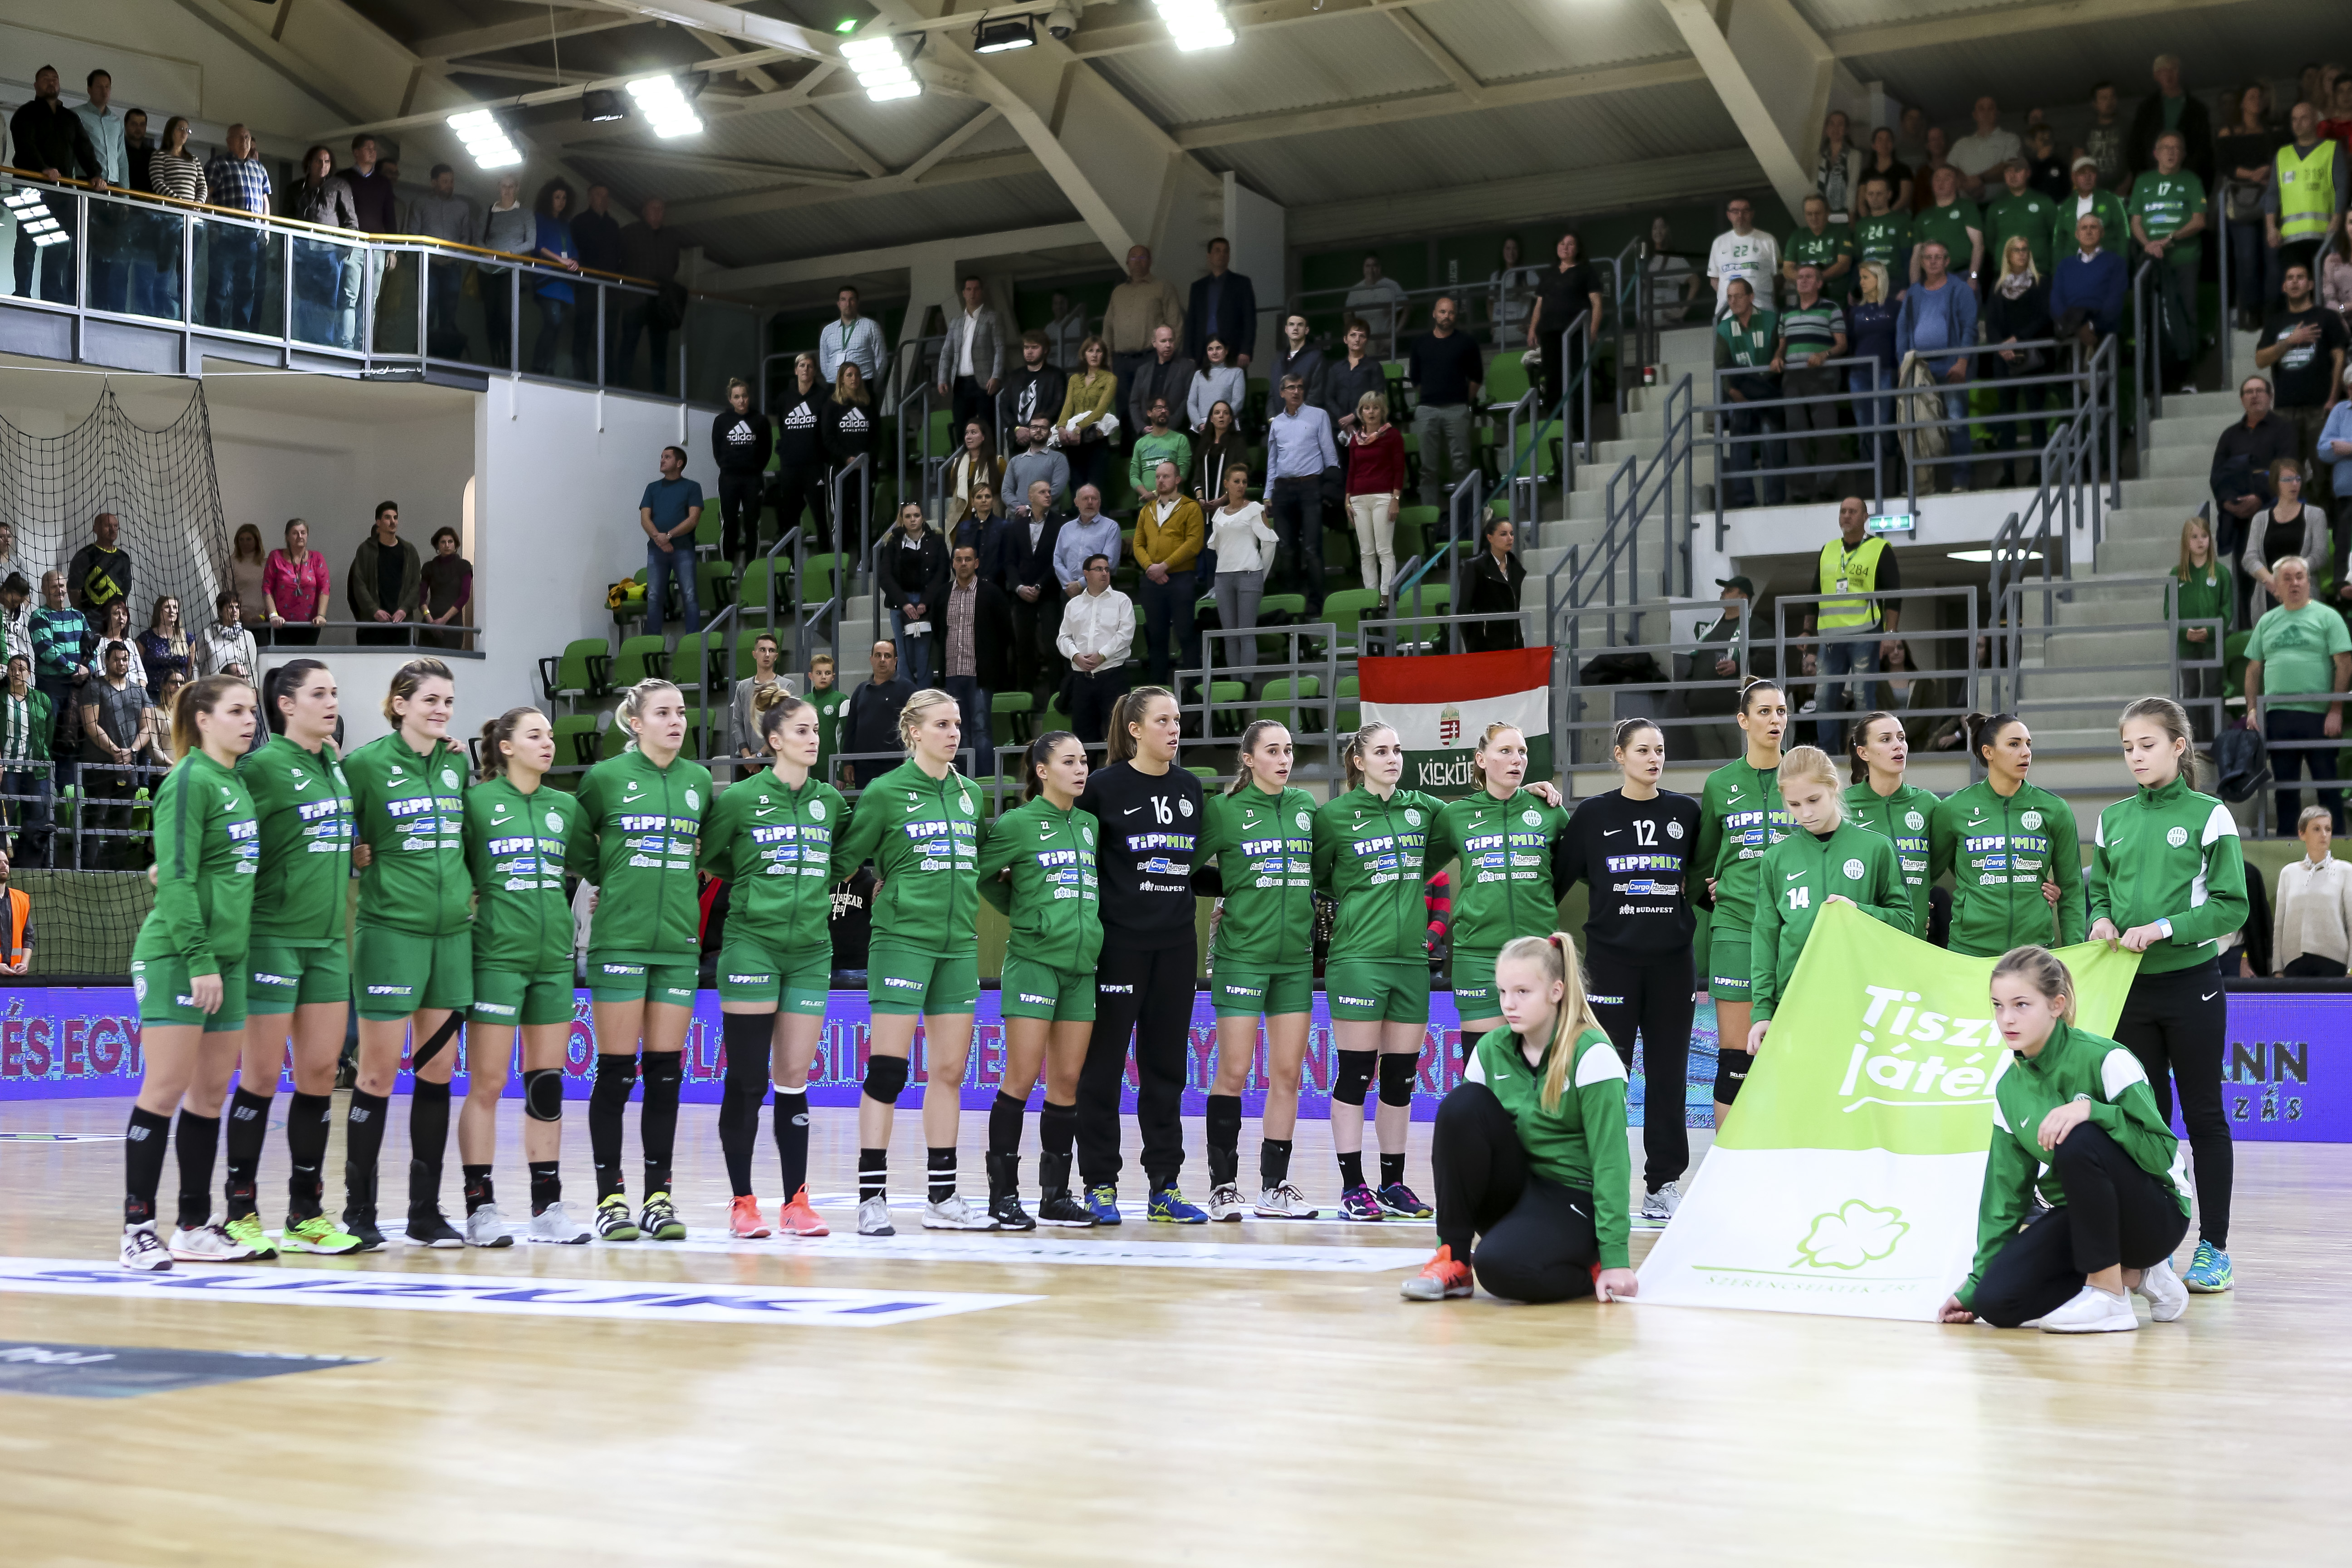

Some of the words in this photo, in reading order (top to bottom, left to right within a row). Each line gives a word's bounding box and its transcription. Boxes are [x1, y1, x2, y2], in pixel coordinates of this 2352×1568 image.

[1733, 245, 1748, 257] 22
[785, 415, 817, 425] adidas
[839, 420, 869, 428] adidas
[727, 433, 756, 441] adidas
[1849, 564, 1869, 577] 284
[1730, 784, 1738, 793] 10
[1150, 795, 1173, 824] 16
[1974, 807, 1980, 815] 8
[1726, 811, 1798, 828] TiPPMI
[1633, 820, 1658, 846] 12
[627, 839, 642, 848] Rail
[1128, 834, 1195, 850] TiPPMIX
[1353, 835, 1424, 855] TiPPMIX
[1465, 835, 1545, 853] TiPPMIX
[1966, 836, 2047, 853] TiPPMIX
[498, 862, 513, 871] Rail
[1608, 857, 1681, 871] TiPPMIX
[1630, 883, 1650, 892] Cargo
[1786, 886, 1811, 910] 14
[729, 975, 770, 984] TiPPMIX
[884, 978, 923, 991] TiPPMIX
[1714, 975, 1749, 987] TiPPMIX
[1226, 985, 1262, 996] TiPPMIX
[1020, 993, 1055, 1006] TiPPMIX
[1338, 996, 1375, 1006] TiPPMIX
[2, 1003, 51, 1076] ÉS
[1, 1269, 938, 1314] SUZUKI
